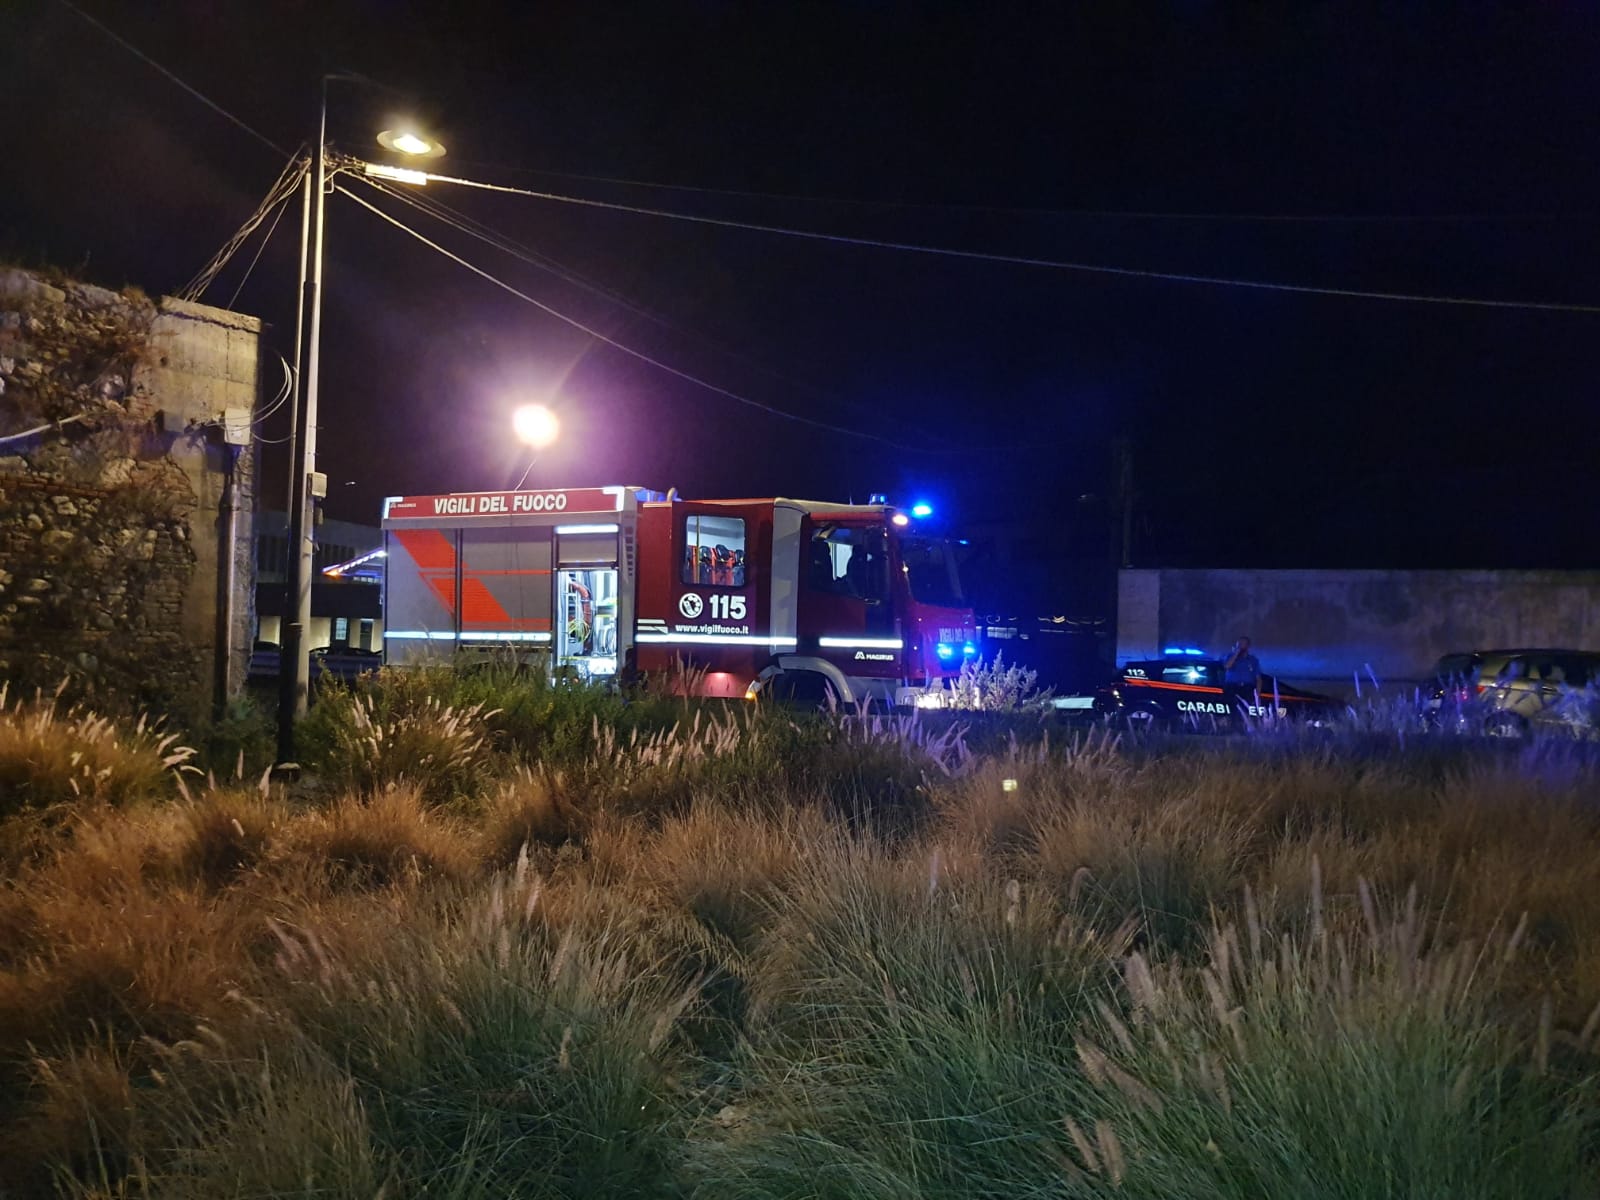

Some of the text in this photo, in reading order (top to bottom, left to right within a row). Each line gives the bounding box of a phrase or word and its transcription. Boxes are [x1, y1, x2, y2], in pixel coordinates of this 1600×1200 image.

[434, 493, 567, 514] VIGILI DEL FUOCO
[709, 594, 747, 620] 115
[675, 624, 749, 635] www.vigilfuoco.it
[1127, 669, 1146, 677] 112
